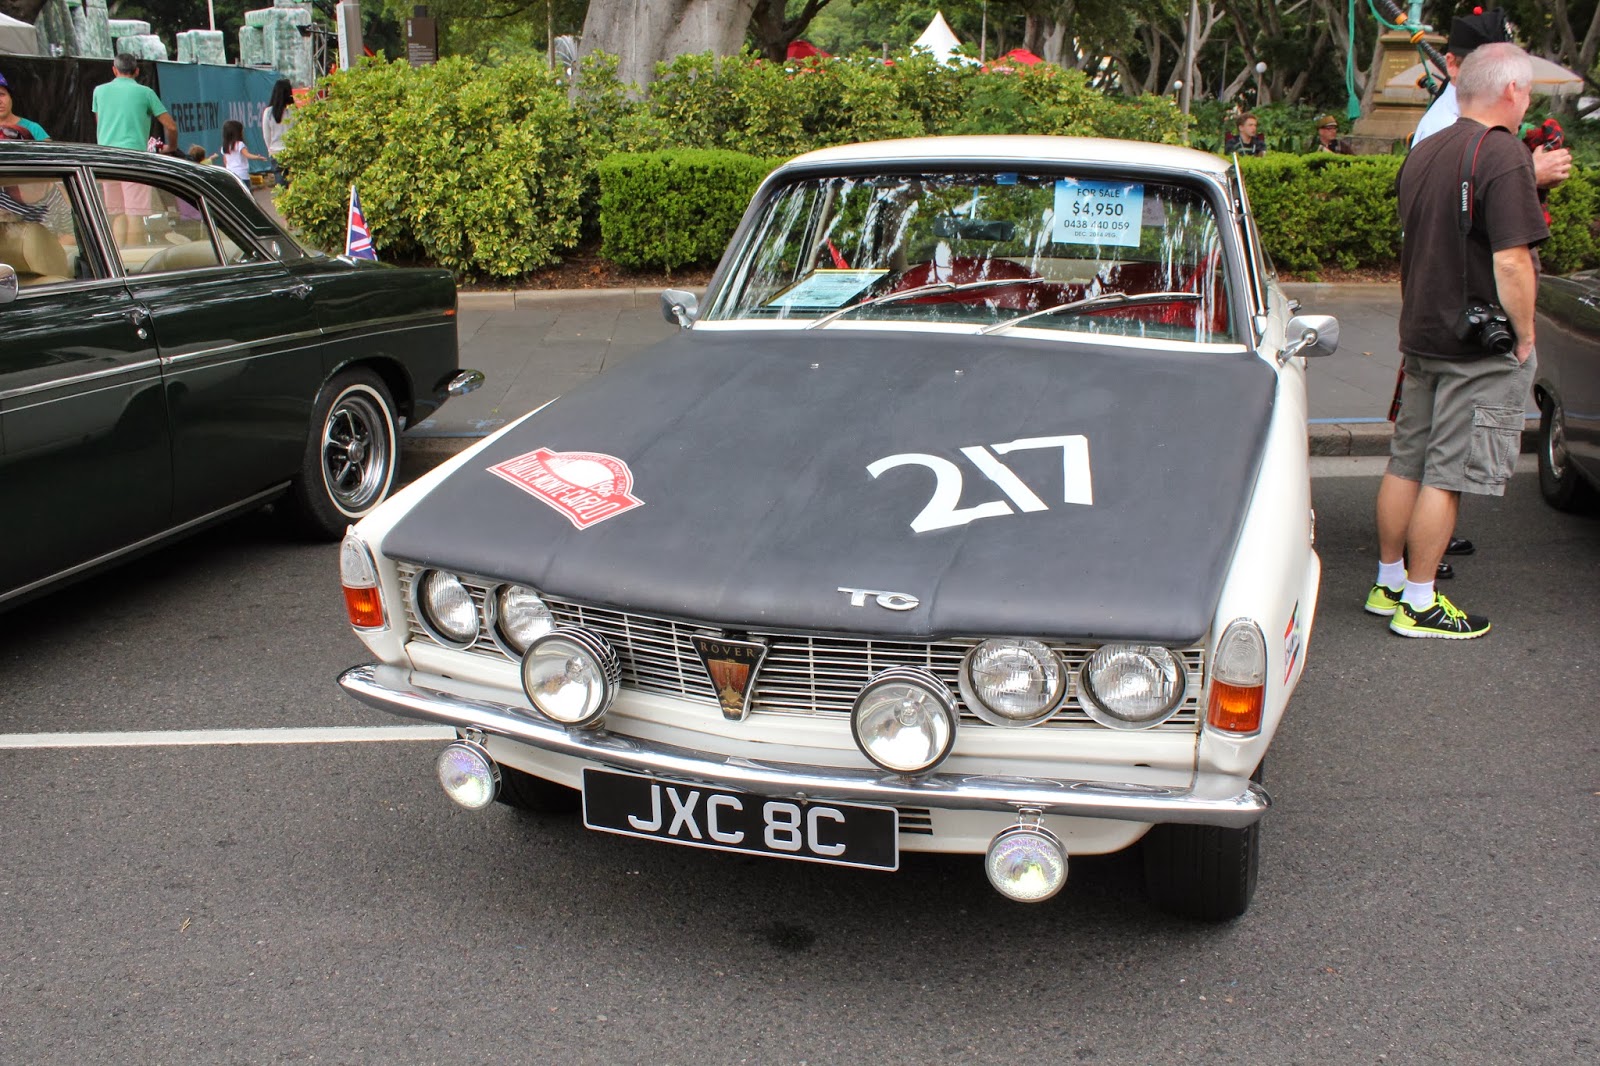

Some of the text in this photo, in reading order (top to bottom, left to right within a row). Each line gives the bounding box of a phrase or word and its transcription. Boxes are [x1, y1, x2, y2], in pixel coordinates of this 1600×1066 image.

[171, 103, 196, 133] FREE
[247, 102, 267, 128] 8-2
[1077, 188, 1120, 199] FOR SALE
[1461, 181, 1469, 212] Canon
[1072, 201, 1124, 217] $4,950
[1063, 219, 1088, 229] 0438
[1111, 221, 1130, 231] 059
[501, 454, 621, 520] RALLYE MONTE-CARLO
[700, 641, 755, 658] ROVER
[628, 784, 846, 857] JXC 8C
